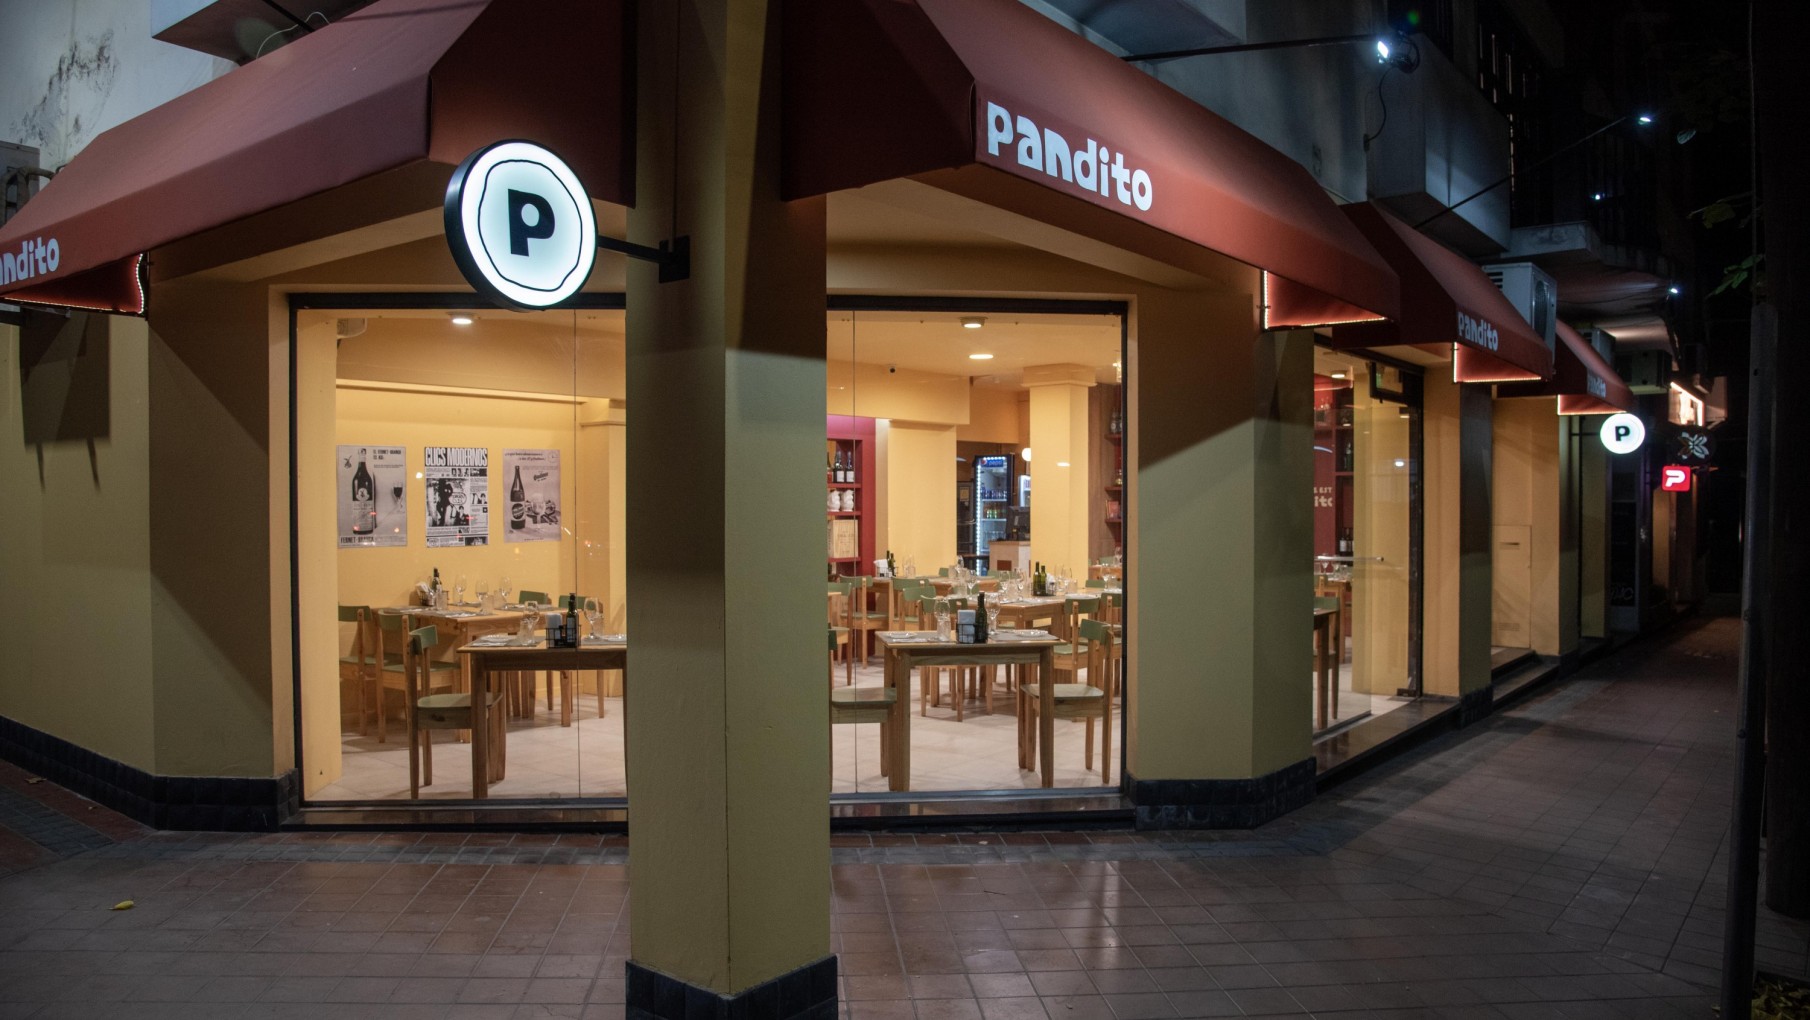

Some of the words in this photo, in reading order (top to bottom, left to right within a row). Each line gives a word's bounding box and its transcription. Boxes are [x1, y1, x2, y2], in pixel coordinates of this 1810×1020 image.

[508, 188, 556, 257] P
[1614, 425, 1632, 442] P
[425, 447, 447, 467] CLICS
[447, 447, 488, 467] MODERNOS
